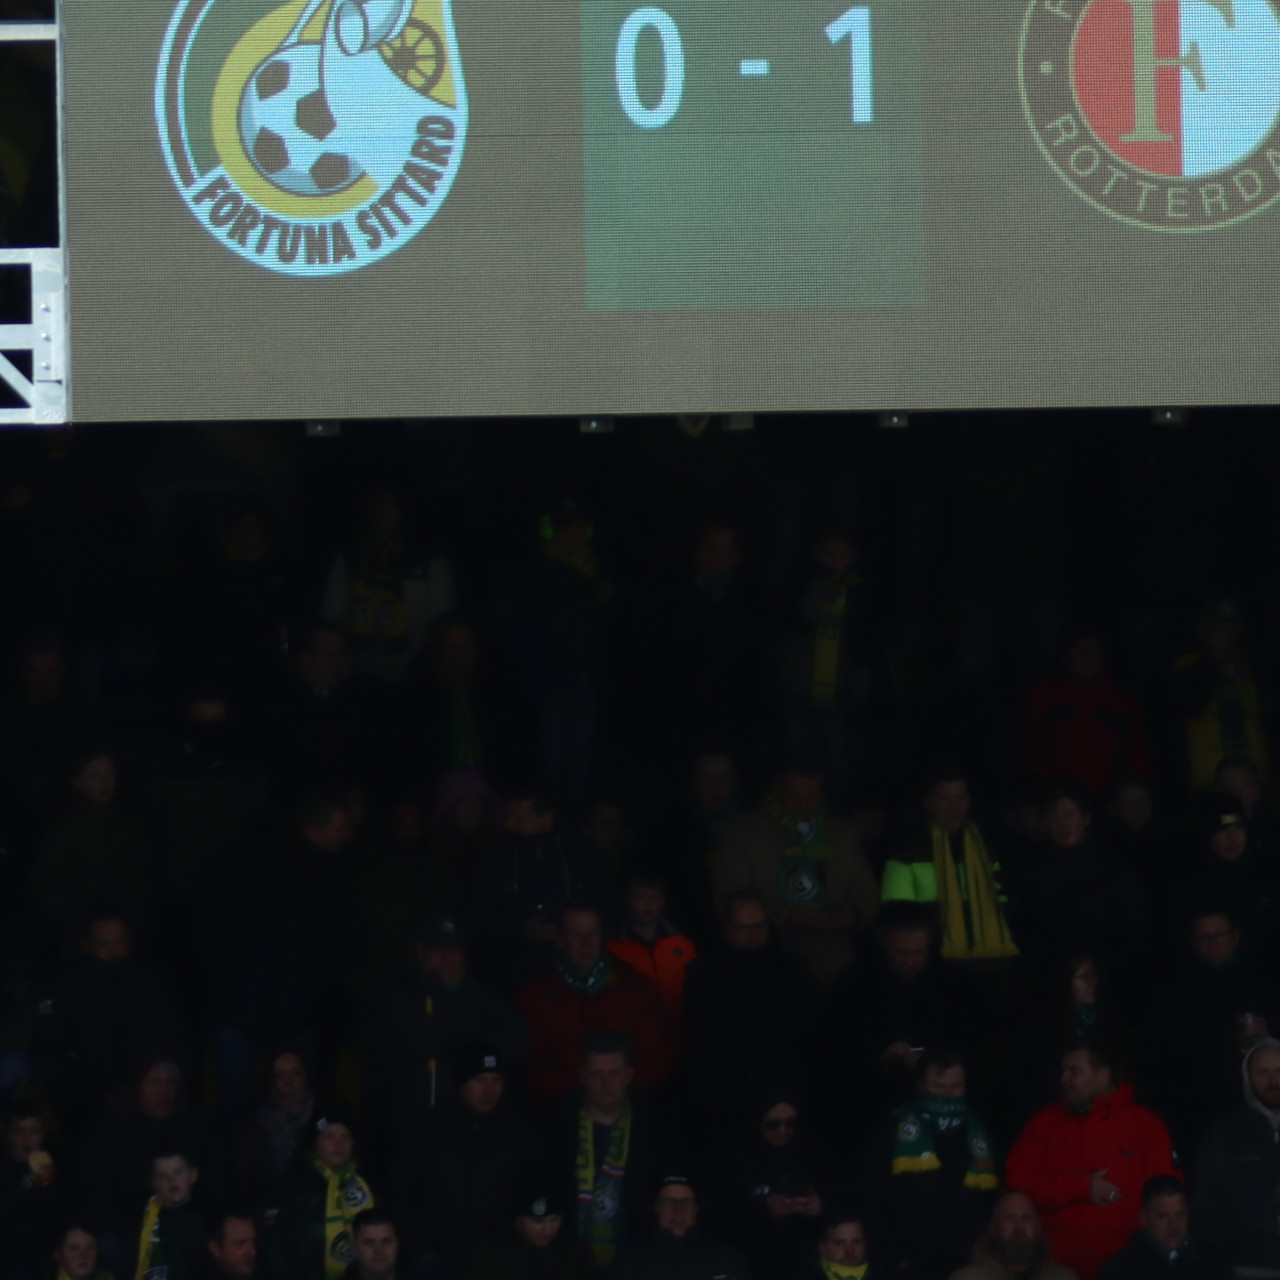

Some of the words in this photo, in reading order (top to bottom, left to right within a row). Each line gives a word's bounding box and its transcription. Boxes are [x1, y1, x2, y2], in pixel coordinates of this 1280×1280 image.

[615, 6, 685, 129] 0
[824, 6, 873, 125] 1
[192, 176, 357, 265] FORTUNA
[357, 115, 455, 250] SITTARD
